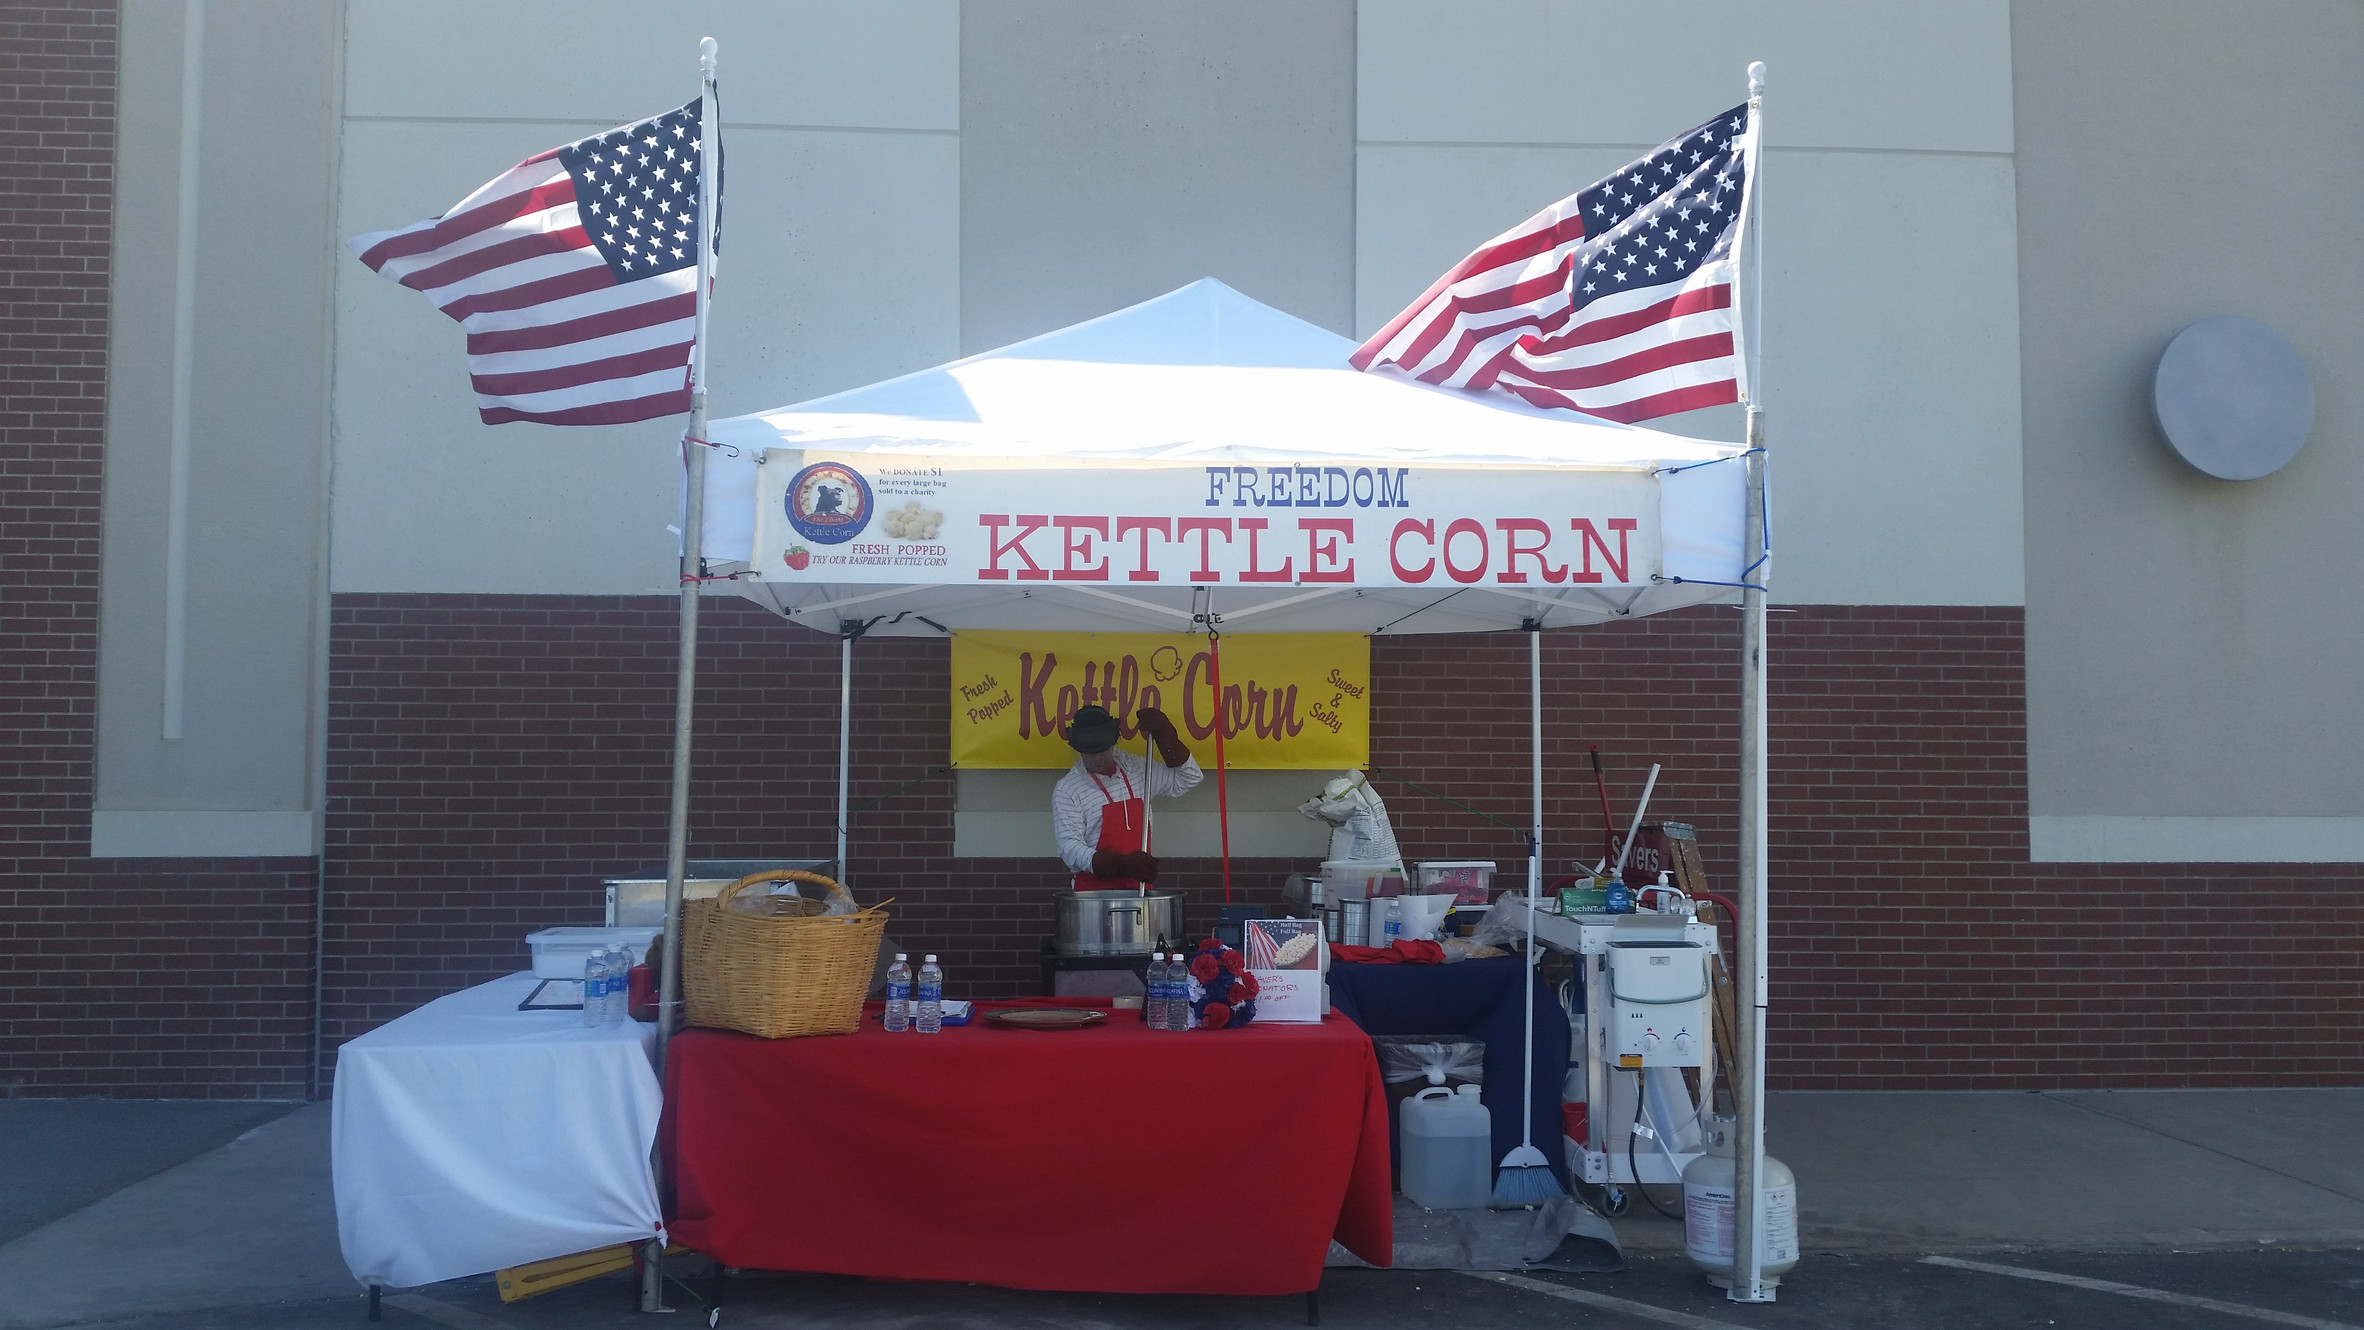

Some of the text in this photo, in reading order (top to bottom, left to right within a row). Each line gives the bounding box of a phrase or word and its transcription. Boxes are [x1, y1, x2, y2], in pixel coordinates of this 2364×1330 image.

[1205, 467, 1410, 508] FREEDOM
[804, 527, 854, 536] Kettle Corn
[812, 556, 948, 567] TRY OUR RASPBERRY KETTLE CORN
[852, 544, 946, 556] FRESH POPPED
[978, 514, 1637, 584] KETTLE CORN
[960, 674, 997, 701] Fresh
[1183, 652, 1304, 741] Corn
[1327, 669, 1365, 699] Sweet
[967, 690, 1014, 724] Popped
[1330, 692, 1342, 708] &
[1309, 703, 1343, 734] Salty
[1256, 975, 1284, 983] AVER'S
[1258, 984, 1299, 992] ONATORS
